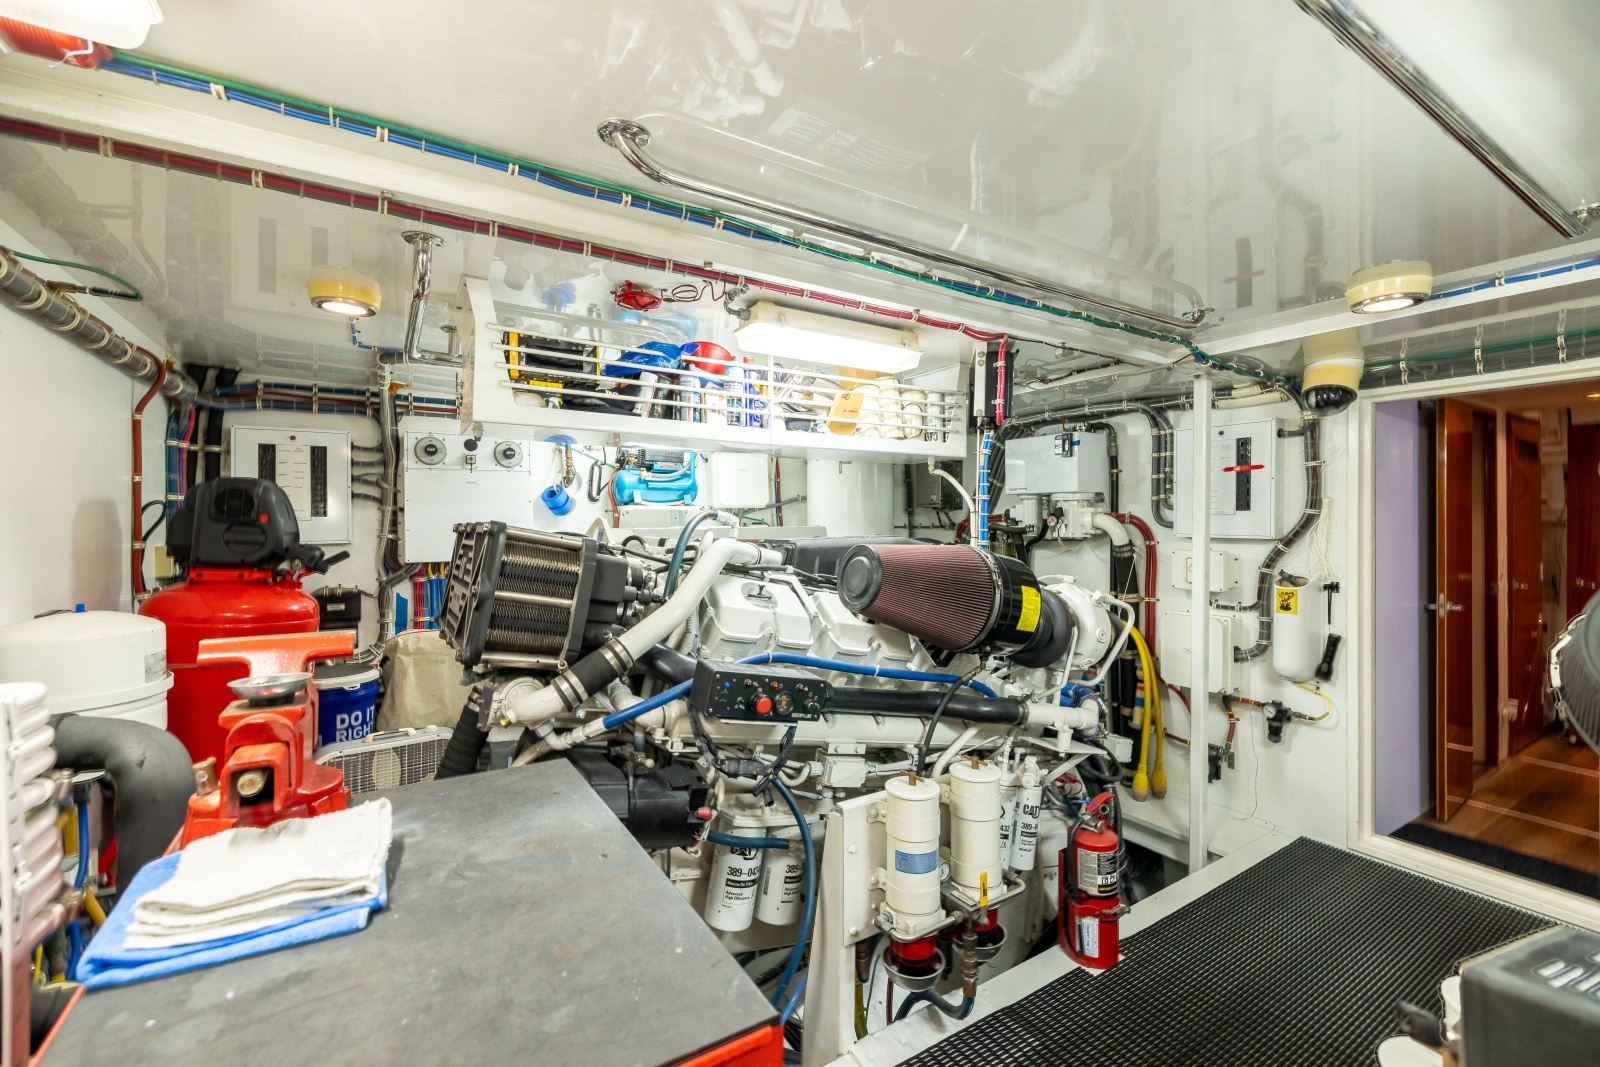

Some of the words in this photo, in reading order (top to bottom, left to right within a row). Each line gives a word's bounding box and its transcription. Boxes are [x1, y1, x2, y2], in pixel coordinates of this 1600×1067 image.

[336, 710, 363, 729] DO
[366, 704, 375, 722] IT
[1023, 804, 1040, 818] CAT
